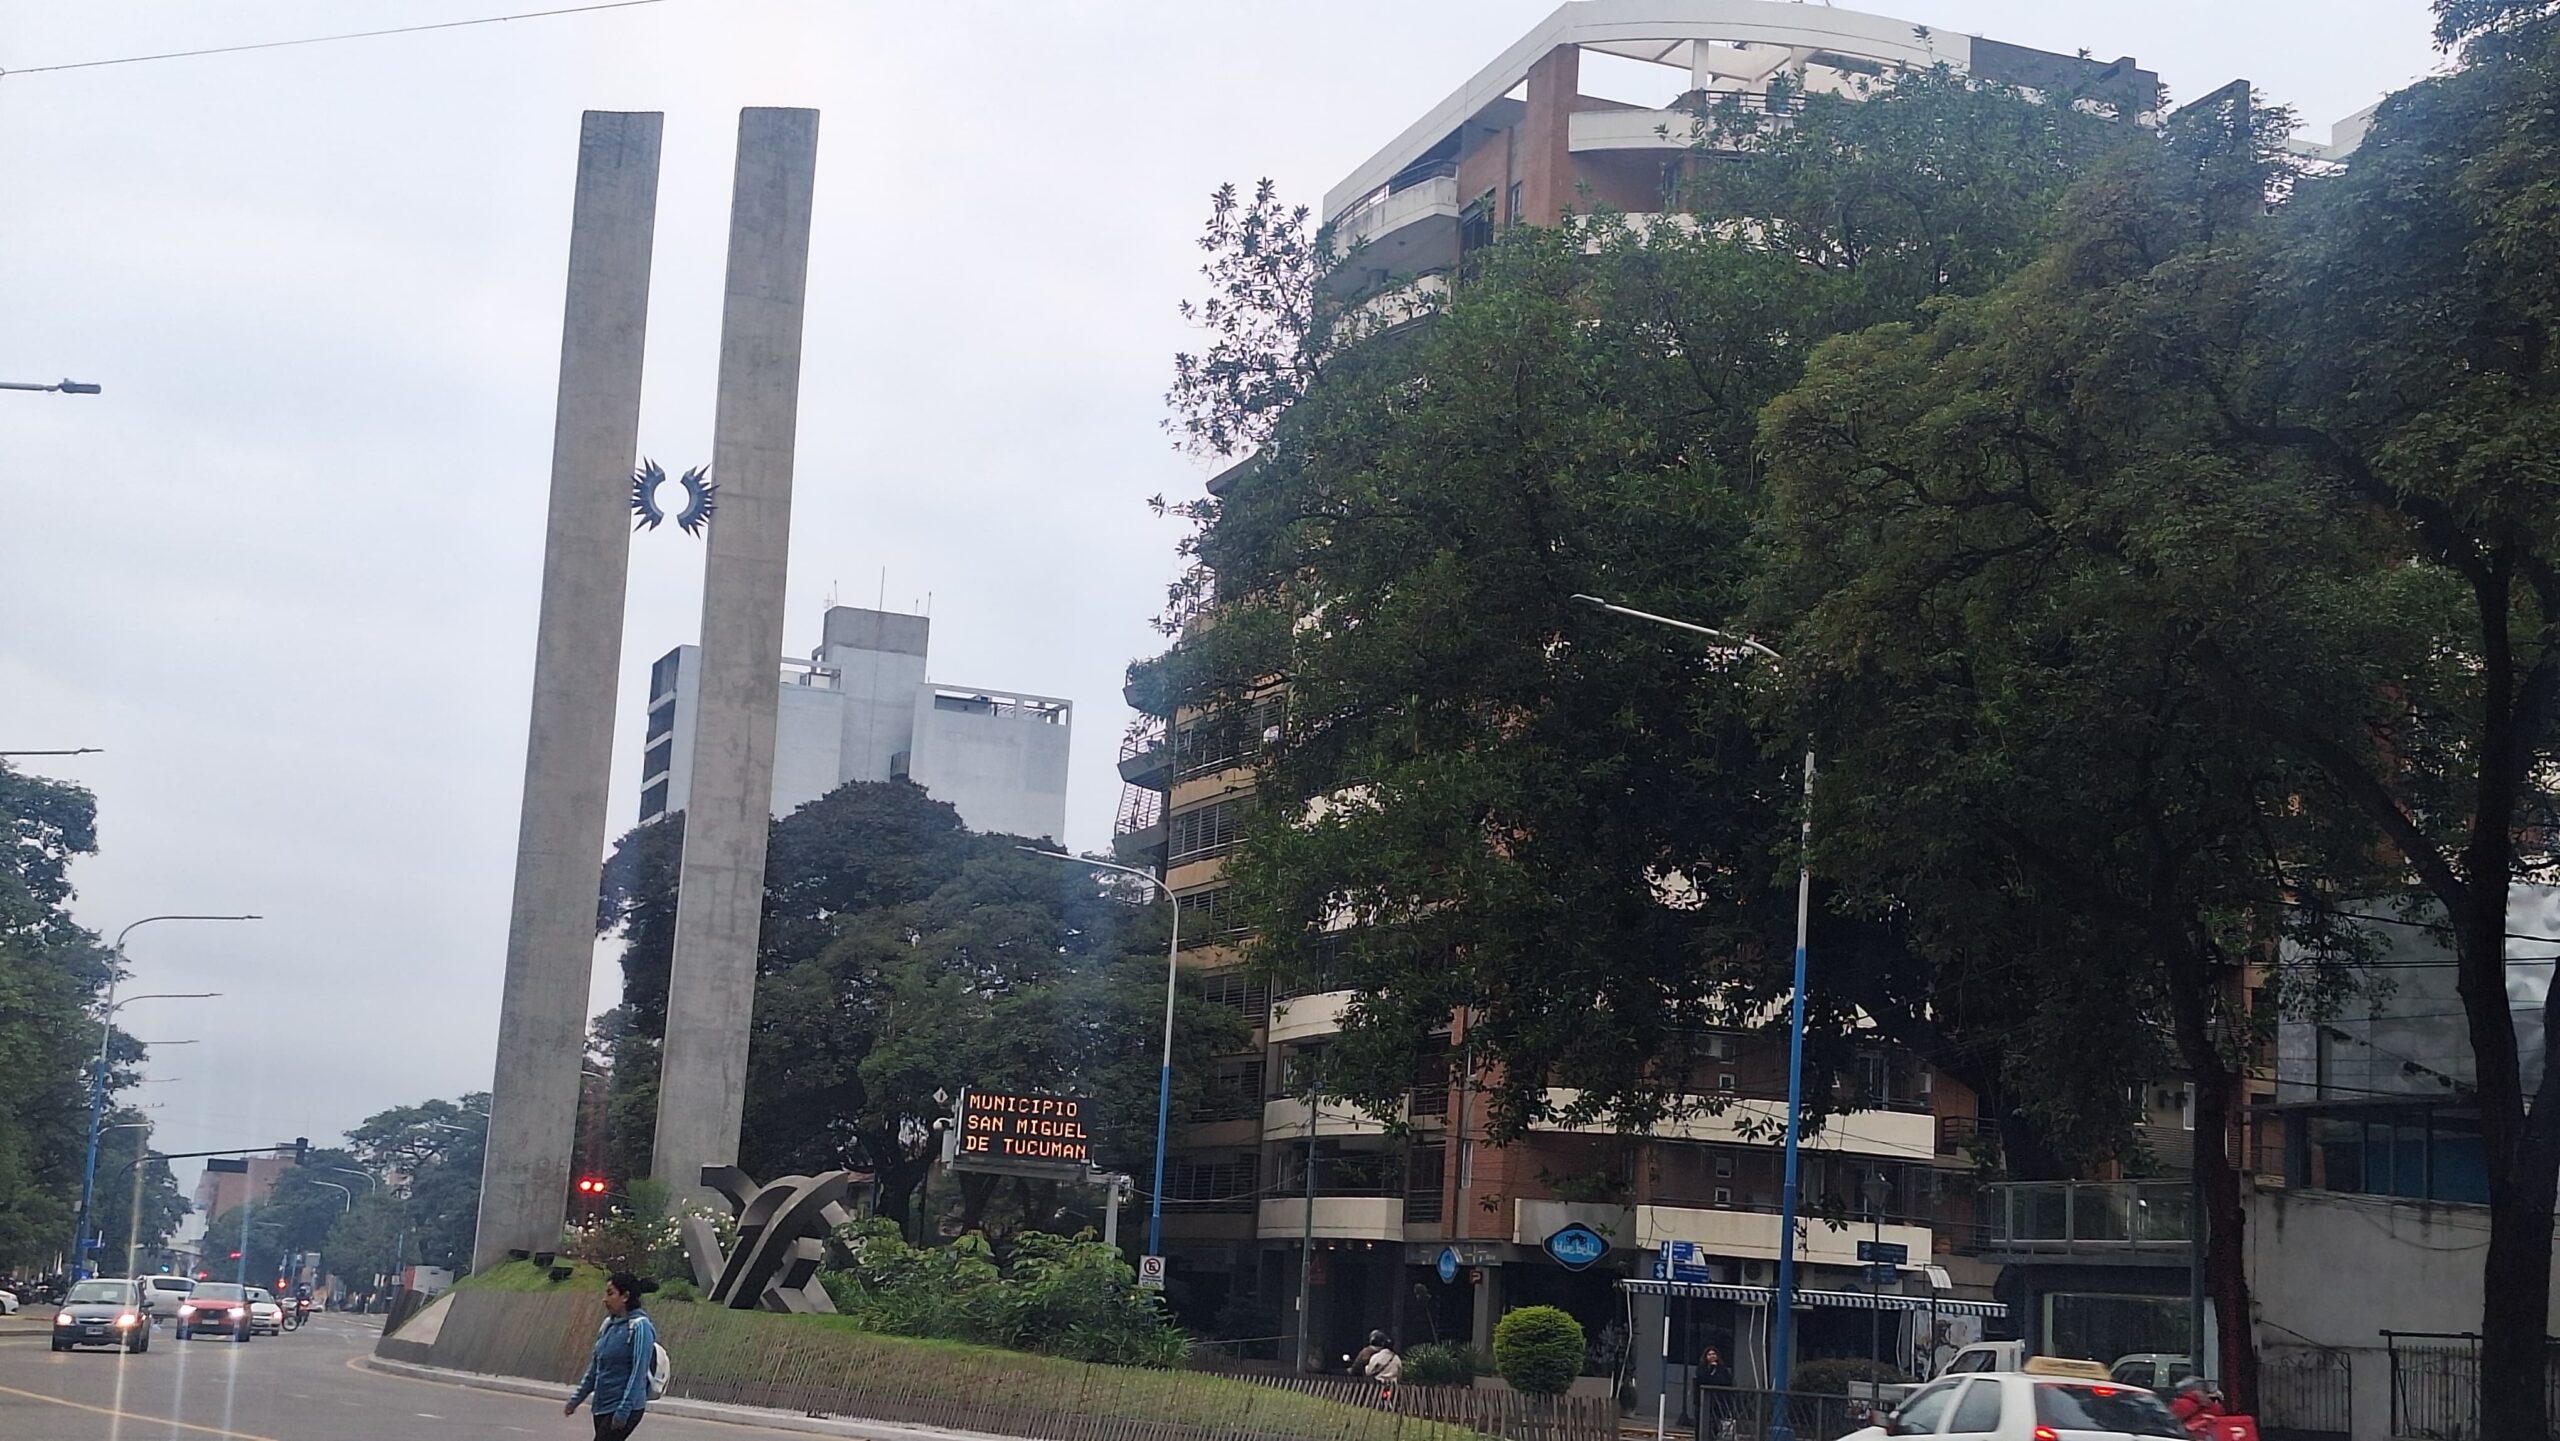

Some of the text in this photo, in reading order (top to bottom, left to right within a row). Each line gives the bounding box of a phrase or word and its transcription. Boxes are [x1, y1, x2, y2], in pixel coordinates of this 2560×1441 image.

[969, 1094, 1077, 1117] MUNICIPIO
[967, 1115, 1087, 1139] SAN MIGUEL
[966, 1135, 1086, 1159] DE TUCUMAN
